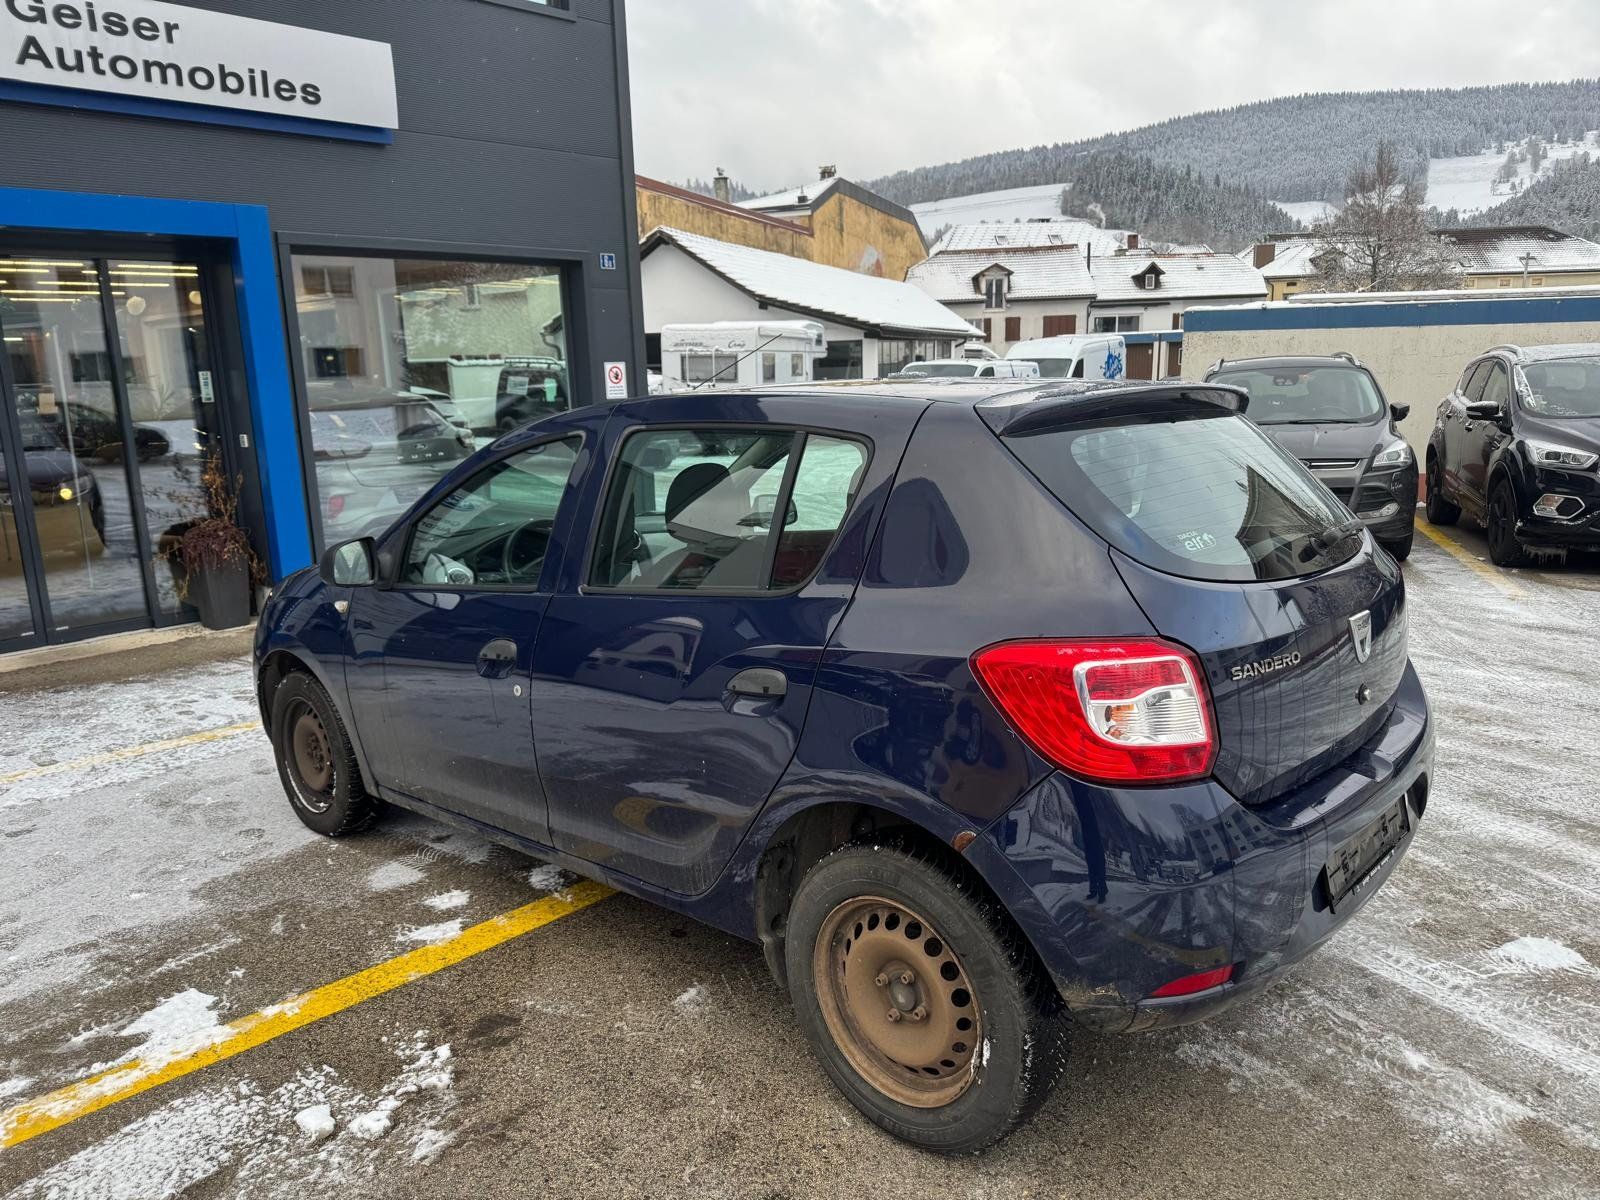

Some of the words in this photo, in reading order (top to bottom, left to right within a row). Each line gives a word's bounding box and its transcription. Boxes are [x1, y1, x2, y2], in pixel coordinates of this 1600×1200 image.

[6, 0, 180, 44] Geiser
[15, 34, 323, 106] Automobiles
[1230, 651, 1301, 681] SANDERO
